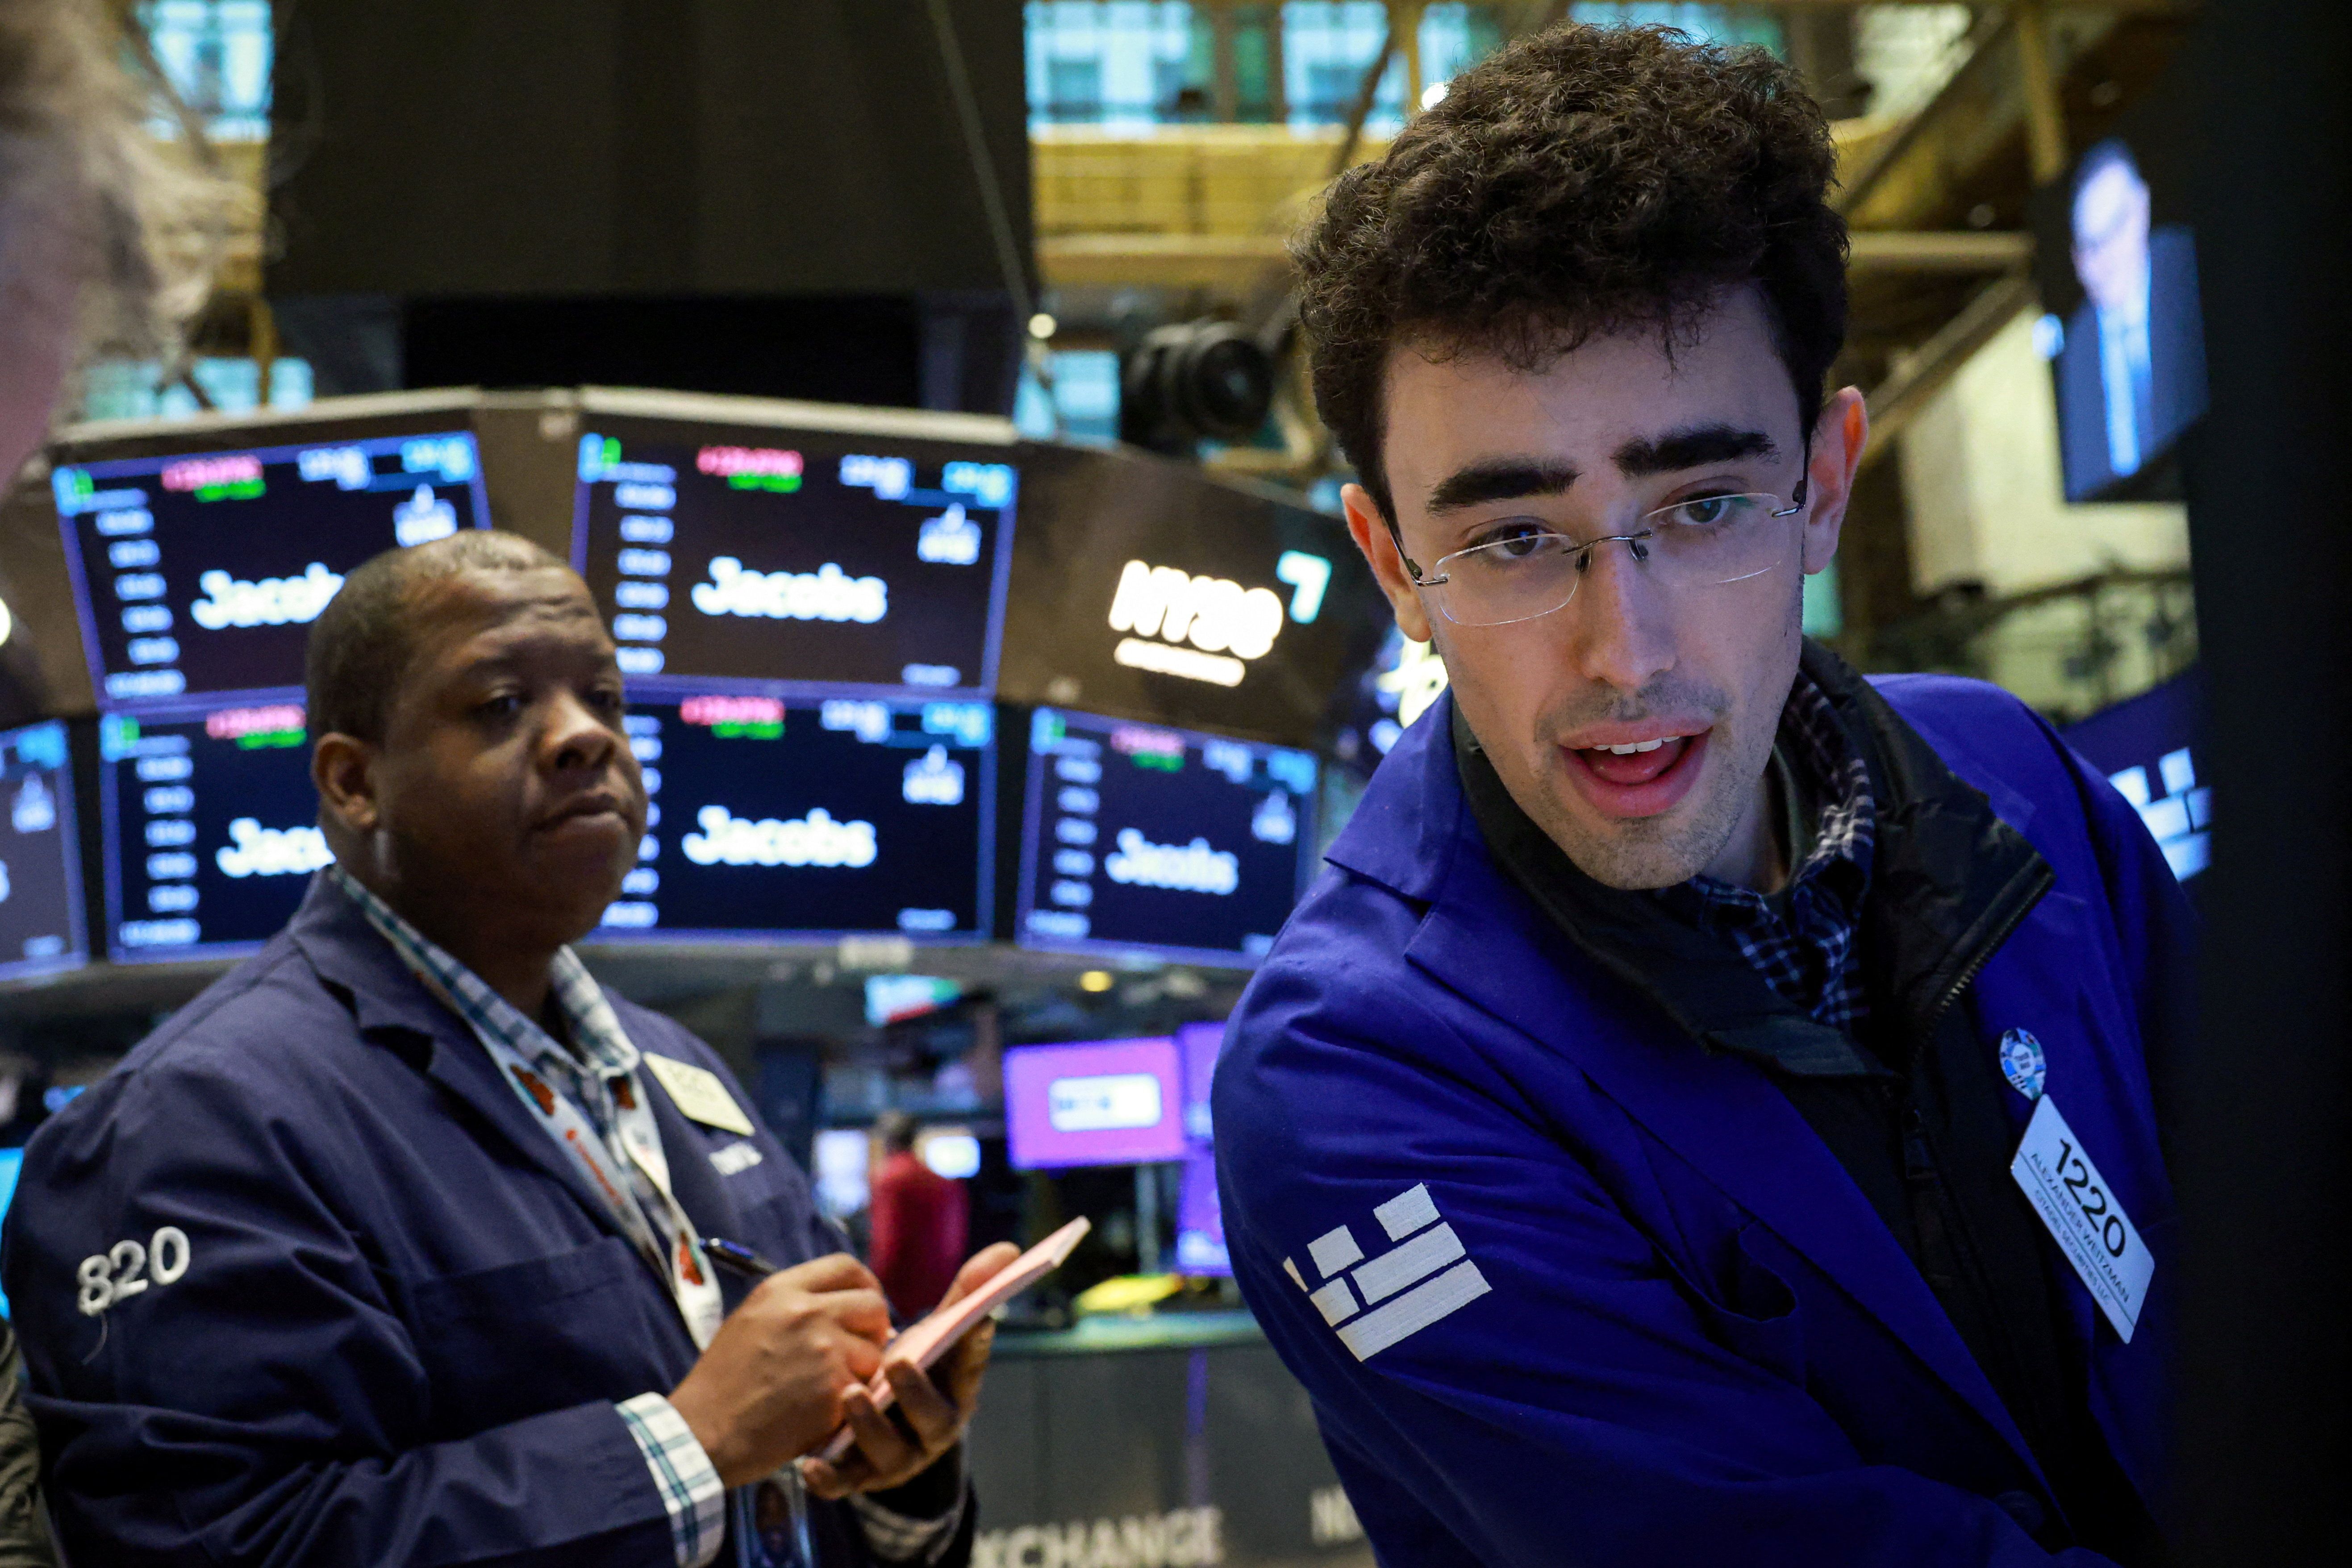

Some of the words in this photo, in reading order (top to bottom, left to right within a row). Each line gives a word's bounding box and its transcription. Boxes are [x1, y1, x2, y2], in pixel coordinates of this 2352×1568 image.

[191, 563, 345, 630] Jacob
[692, 556, 887, 623] Jacobs
[682, 805, 876, 867] Jacobs
[1105, 828, 1238, 894] Jacobs
[2054, 1138, 2127, 1259] 1220
[77, 1226, 190, 1316] 820
[967, 1505, 1224, 1568] XCHANGE
